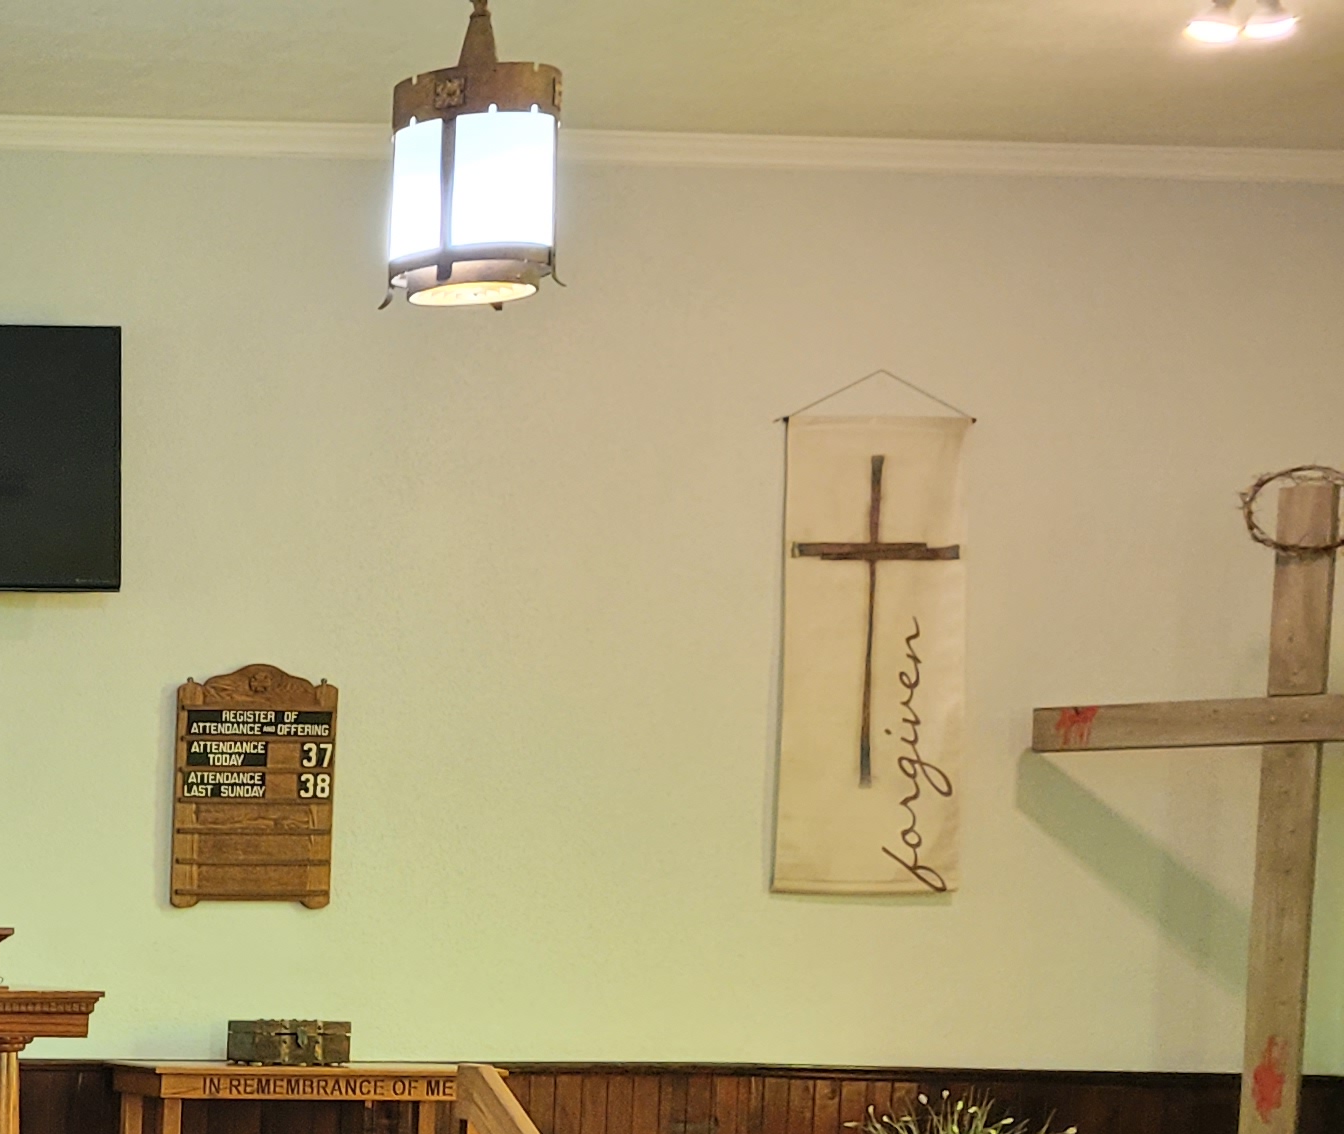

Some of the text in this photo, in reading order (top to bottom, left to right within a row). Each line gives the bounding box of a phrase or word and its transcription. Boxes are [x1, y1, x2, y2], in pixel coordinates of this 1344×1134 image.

[222, 710, 298, 722] REGISTER OF
[190, 722, 329, 736] ATTENDANCE AND OFFERING
[190, 741, 266, 754] ATTENDANCE
[881, 616, 952, 892] forgiven
[207, 754, 245, 766] TODAY
[302, 742, 333, 768] 37
[188, 772, 262, 784] ATTENDANCE
[183, 785, 265, 797] LAST SUNDAY
[299, 773, 330, 798] 38
[202, 1076, 454, 1097] IN REMEMBRANCE OF ME
